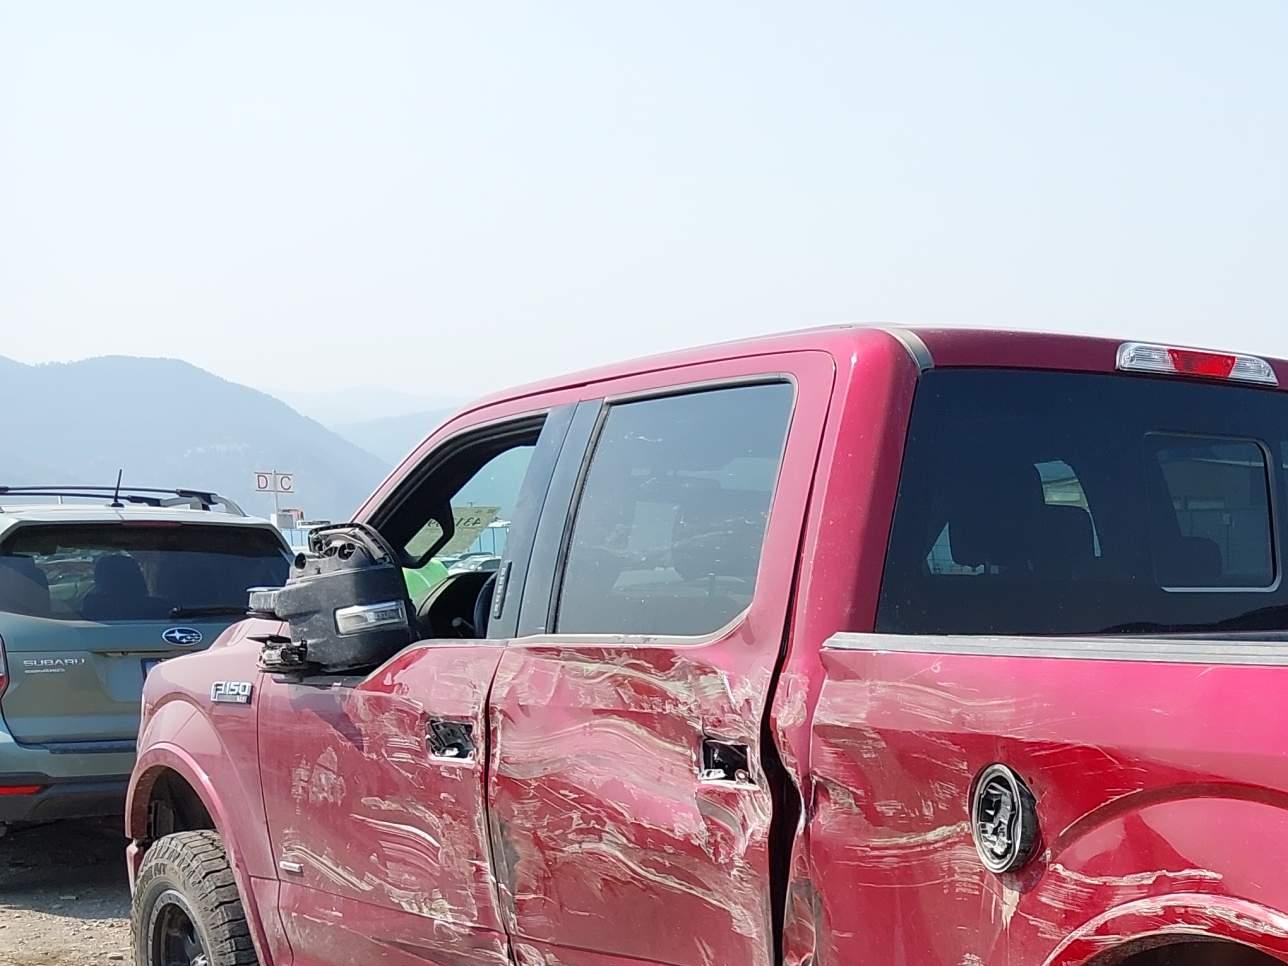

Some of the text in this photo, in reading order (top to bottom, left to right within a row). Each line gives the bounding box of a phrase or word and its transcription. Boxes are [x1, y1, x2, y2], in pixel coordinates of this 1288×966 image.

[257, 474, 292, 491] D C
[23, 658, 86, 667] SUBARU
